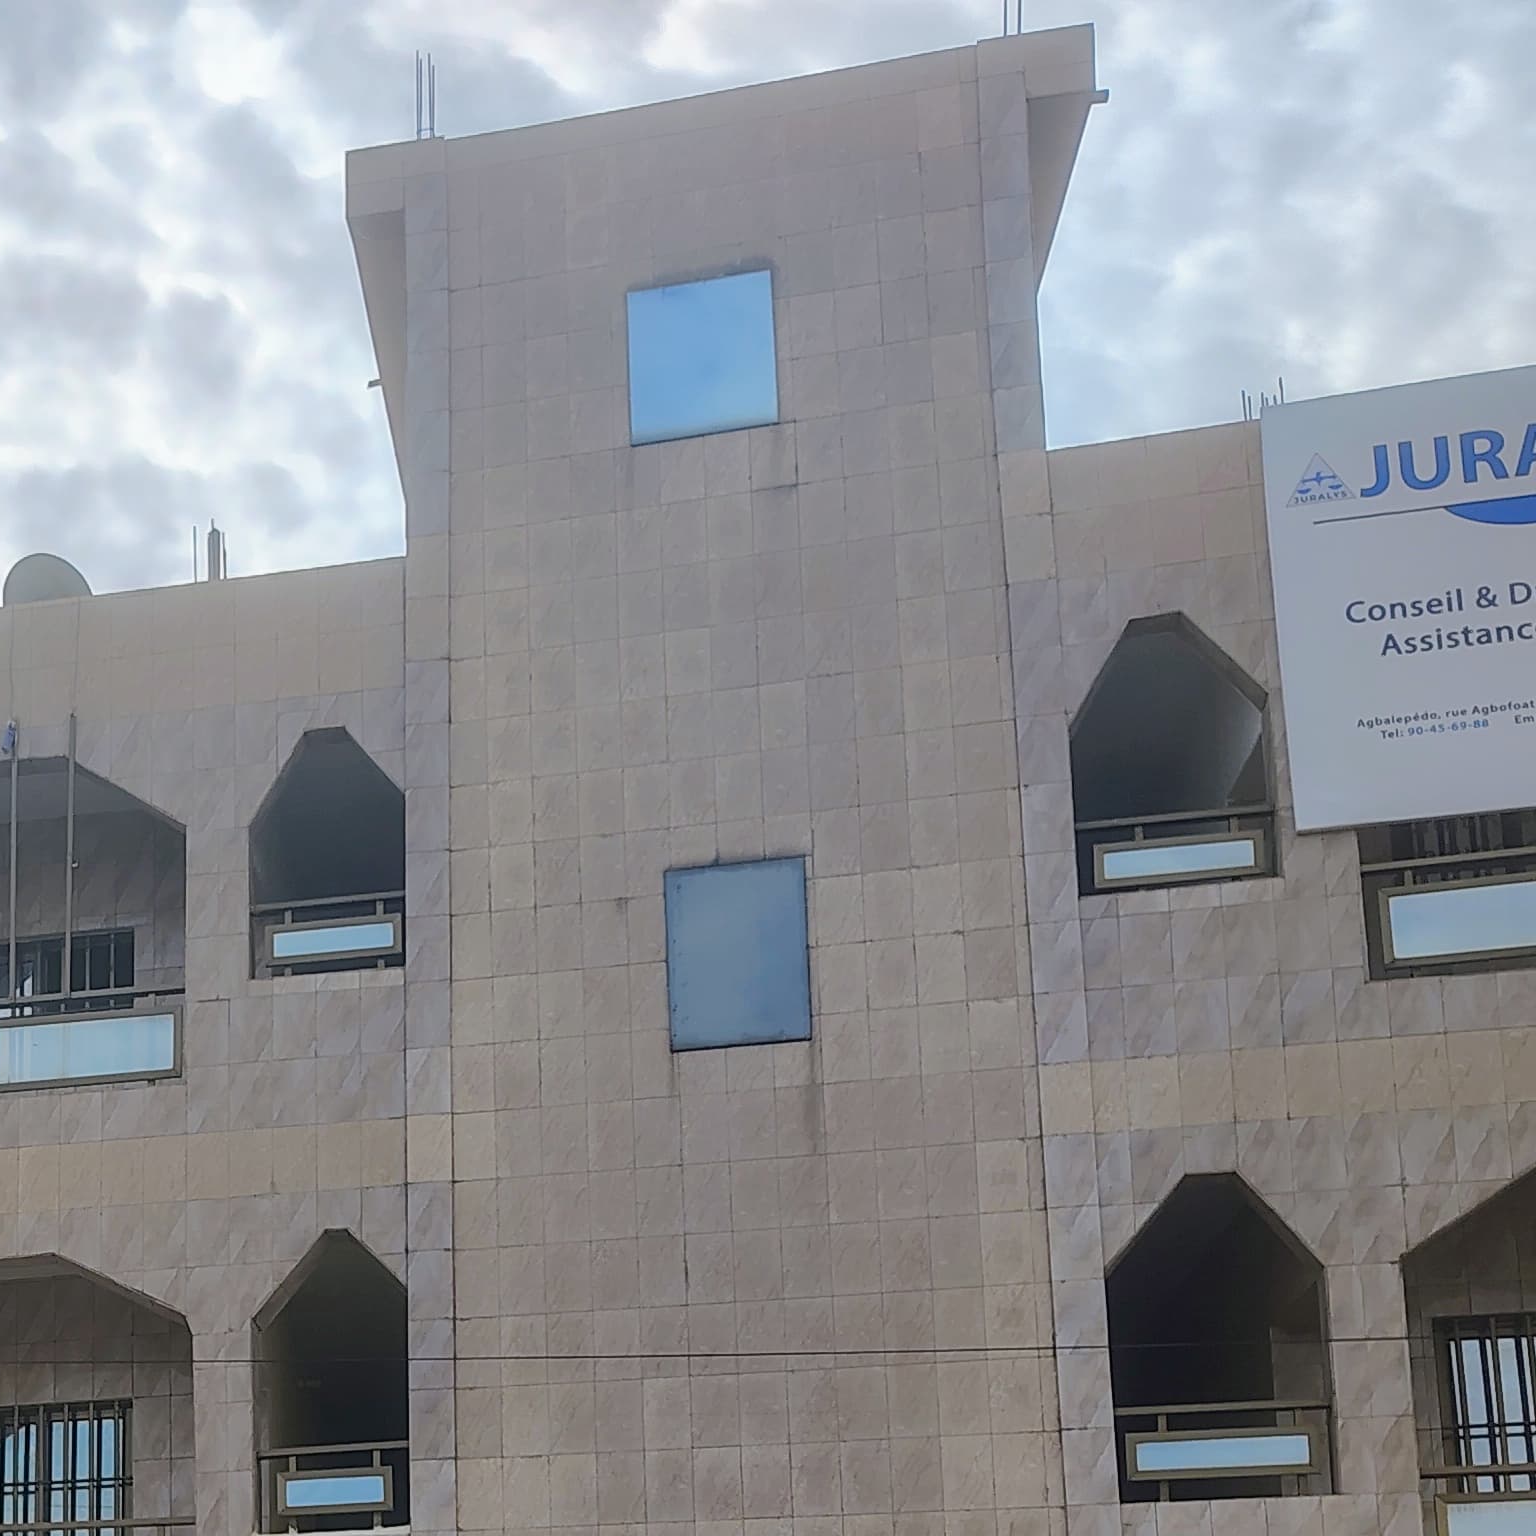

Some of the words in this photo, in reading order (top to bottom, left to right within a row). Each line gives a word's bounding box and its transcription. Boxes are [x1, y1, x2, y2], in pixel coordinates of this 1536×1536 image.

[1346, 588, 1464, 623] Conseil
[1476, 586, 1499, 609] &
[1509, 581, 1536, 605] D
[1381, 622, 1536, 657] Assistanc
[1445, 707, 1468, 718] rue
[1380, 728, 1405, 739] Tel:
